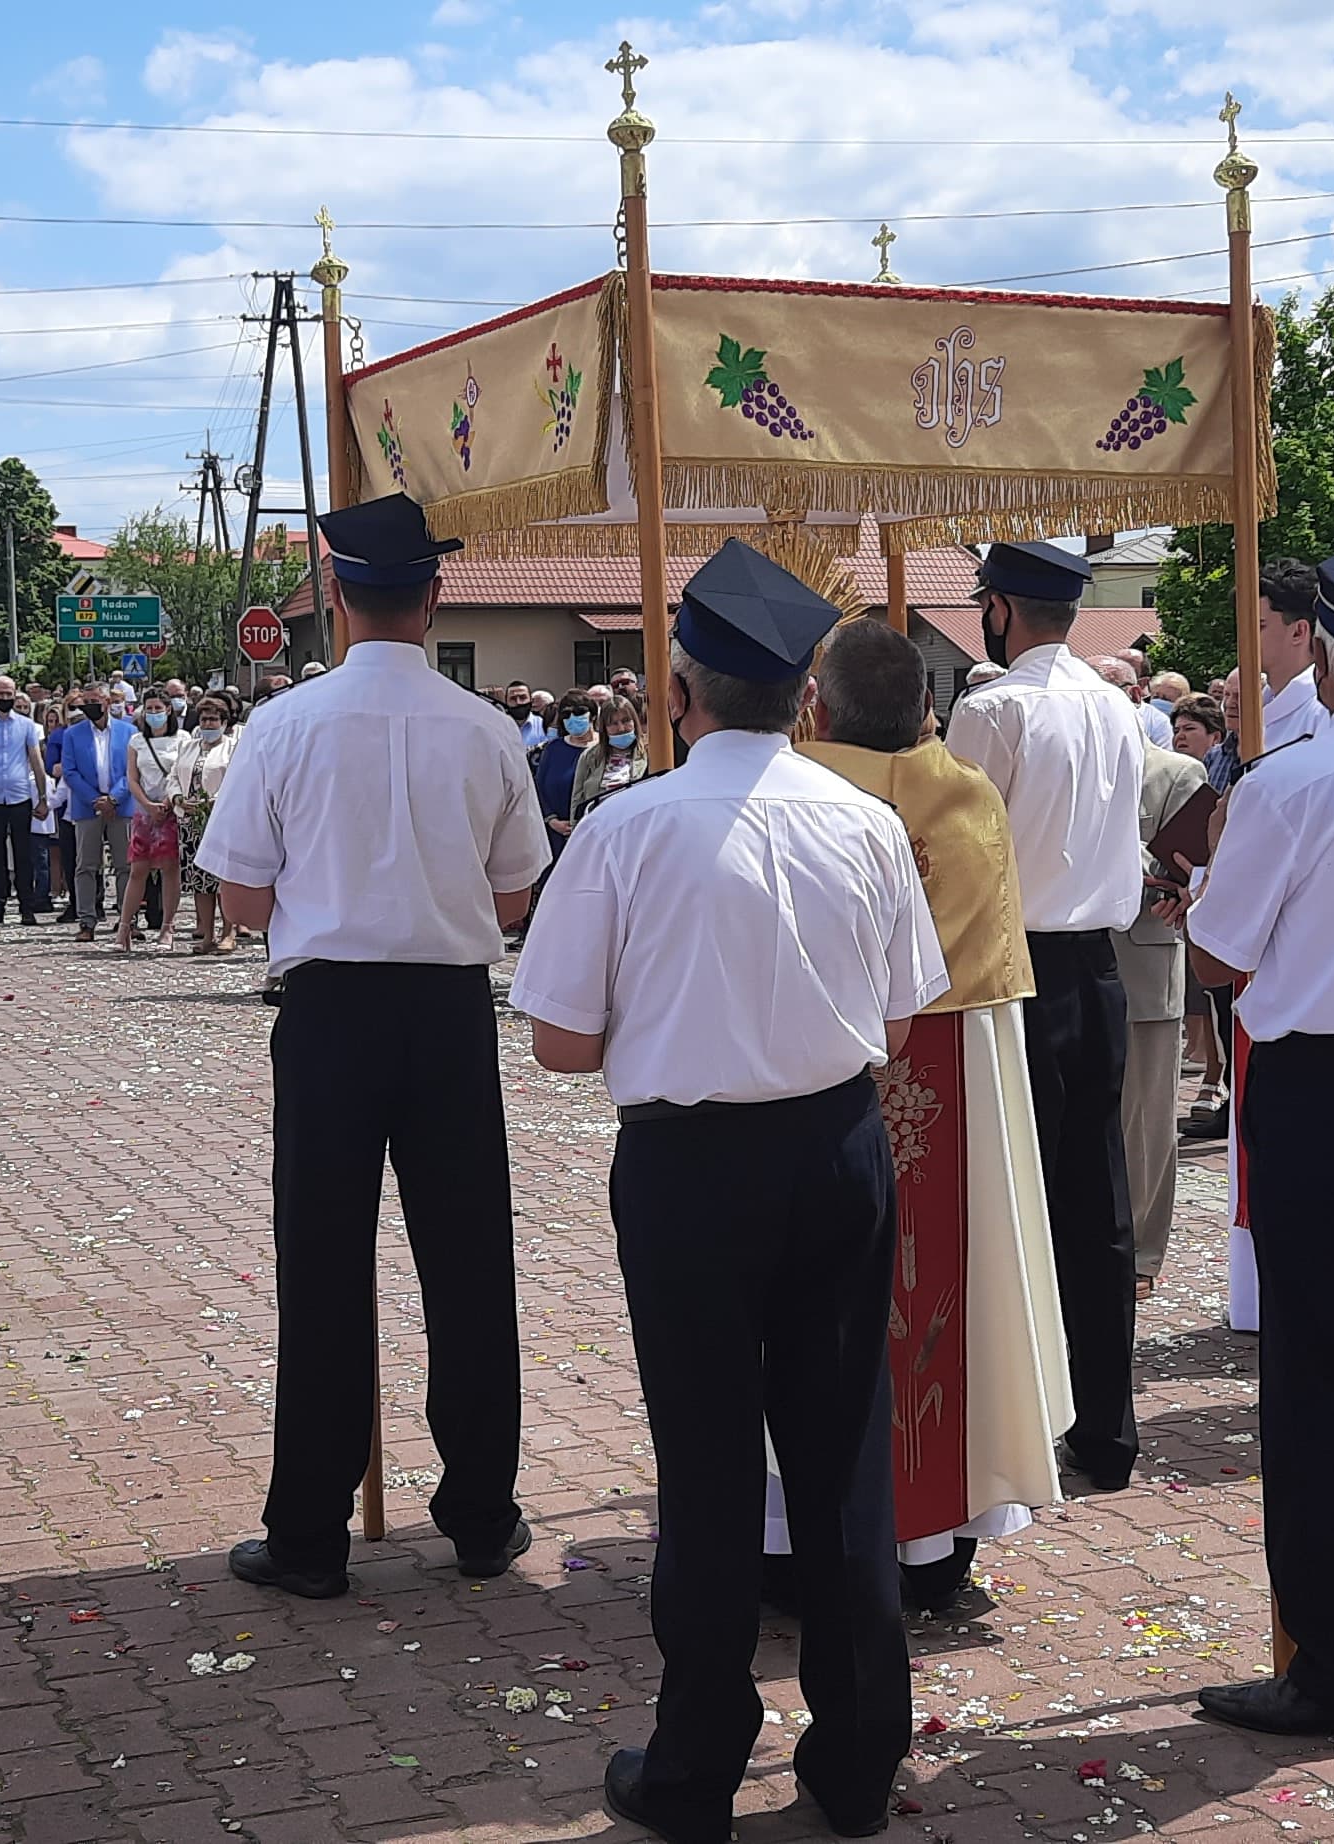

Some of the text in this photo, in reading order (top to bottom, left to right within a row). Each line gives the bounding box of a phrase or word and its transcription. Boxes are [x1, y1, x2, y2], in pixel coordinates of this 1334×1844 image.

[101, 599, 138, 608] Radom
[101, 612, 131, 621] Nisko
[102, 628, 144, 638] Rzeszów
[243, 626, 279, 644] STOP
